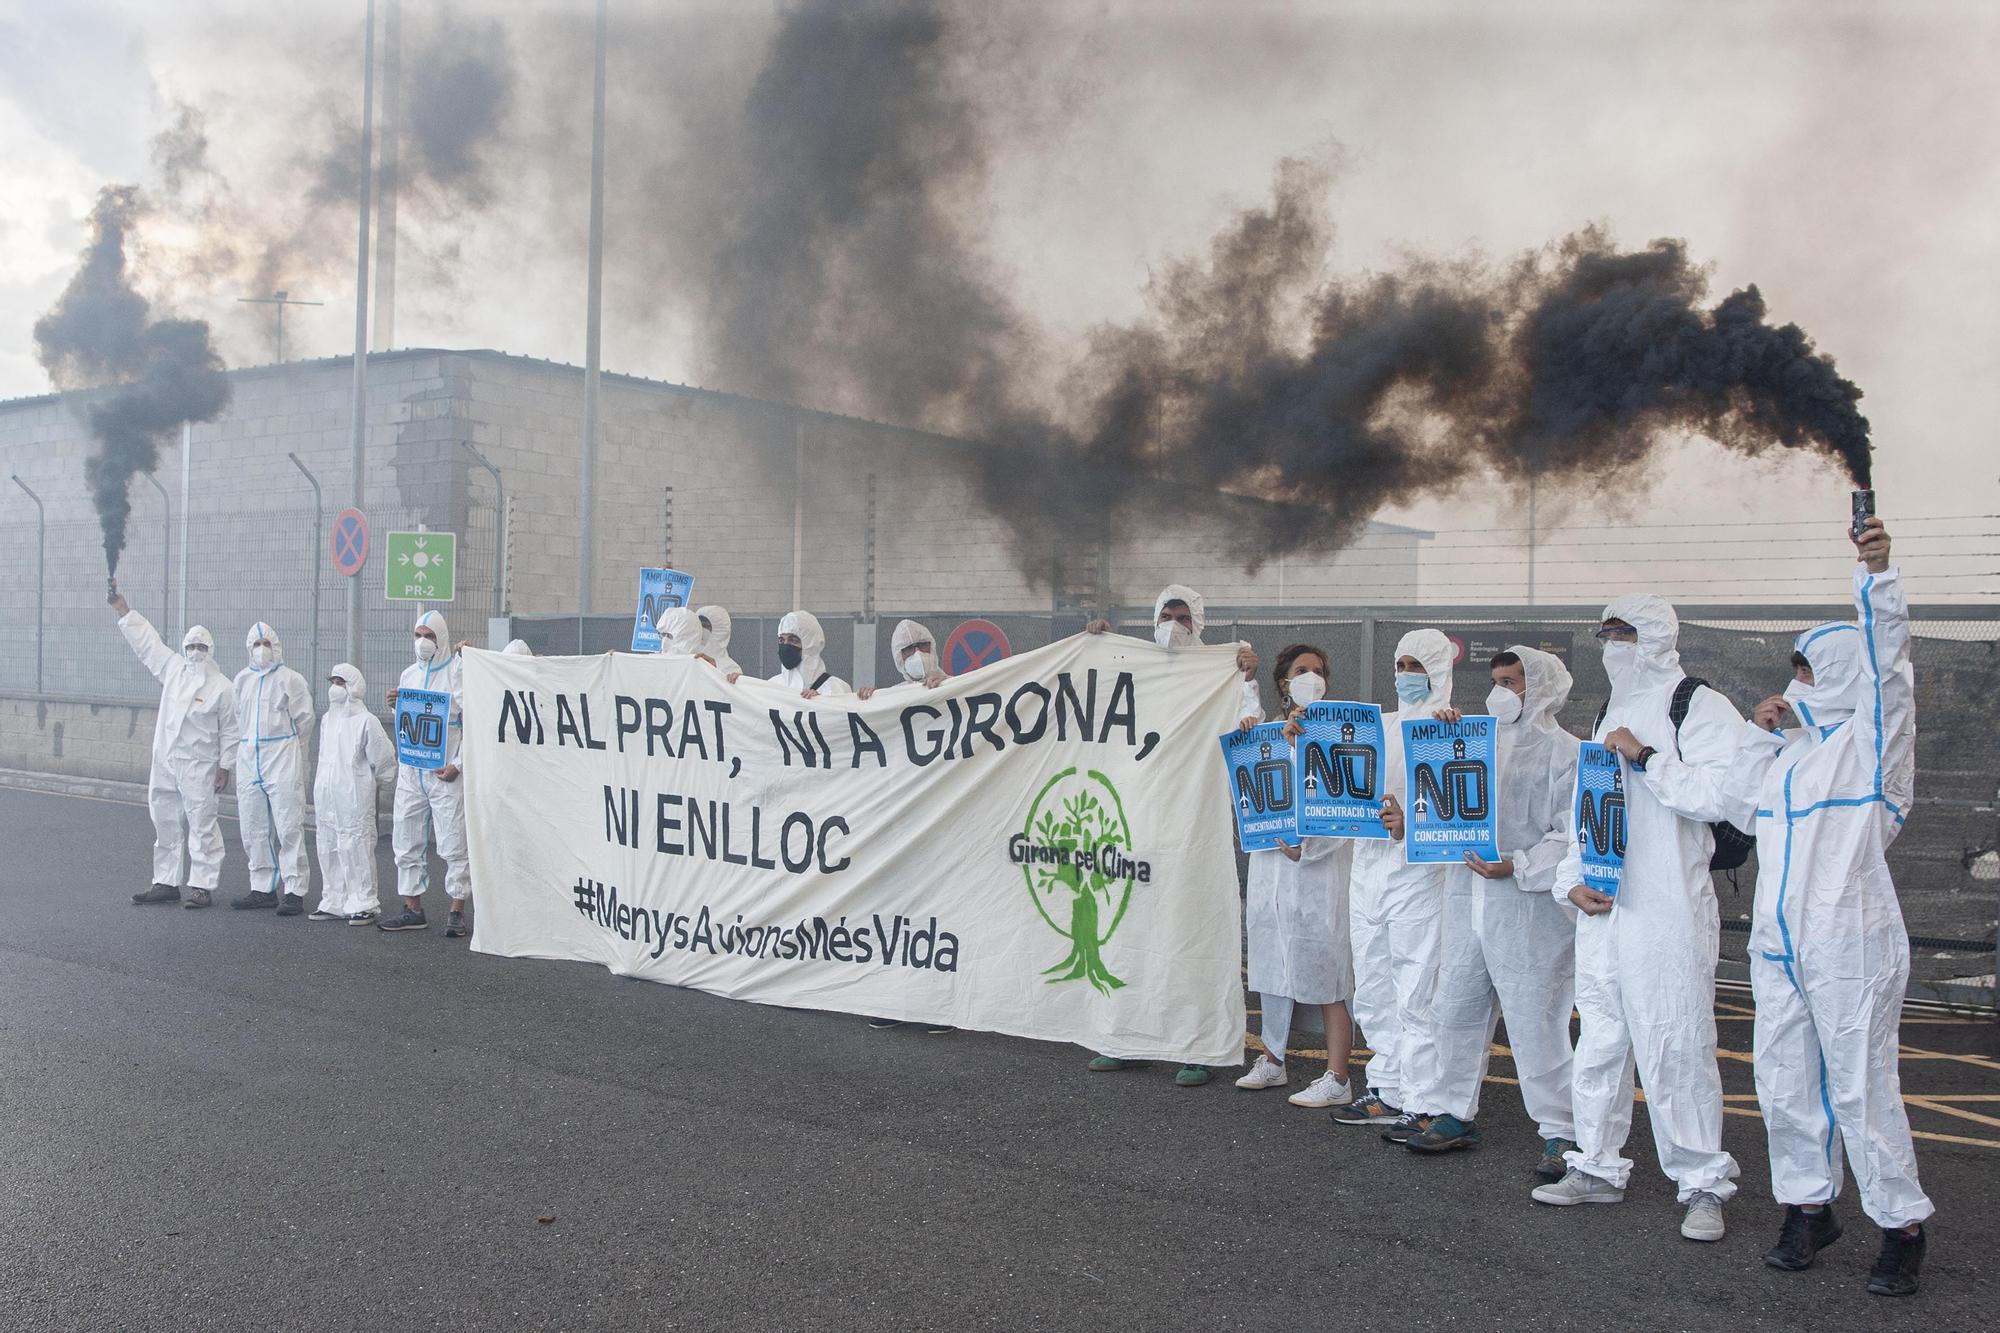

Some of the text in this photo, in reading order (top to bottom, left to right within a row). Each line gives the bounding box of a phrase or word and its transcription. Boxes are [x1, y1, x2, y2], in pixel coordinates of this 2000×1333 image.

[645, 572, 689, 585] AMPLIACIONS
[405, 585, 435, 596] PR-2
[403, 692, 446, 704] AMPLIACIONS
[498, 668, 1161, 779] NI AL PRAT, NI A GIRONA,
[1303, 707, 1375, 724] AMPLIACIONS
[400, 711, 443, 747] NO
[1229, 727, 1284, 749] AMPLIACION
[1411, 721, 1488, 741] AMPLIACIONS
[1304, 742, 1377, 801] NO
[1235, 759, 1292, 815] NO
[1414, 760, 1489, 822] NO
[1305, 805, 1365, 818] CONCENTRACIÓ
[1366, 807, 1380, 819] 19S
[603, 785, 851, 875] NI ENLLOC
[1243, 818, 1283, 833] CONCENTRACIÓ
[1283, 817, 1296, 828] 19S
[1414, 828, 1490, 842] CONCENTRACIÓ 19S
[1008, 832, 1151, 883] Girona pel Clima
[1583, 863, 1622, 879] NCENTRAC
[573, 877, 960, 973] #MenysAvionsMésVida
